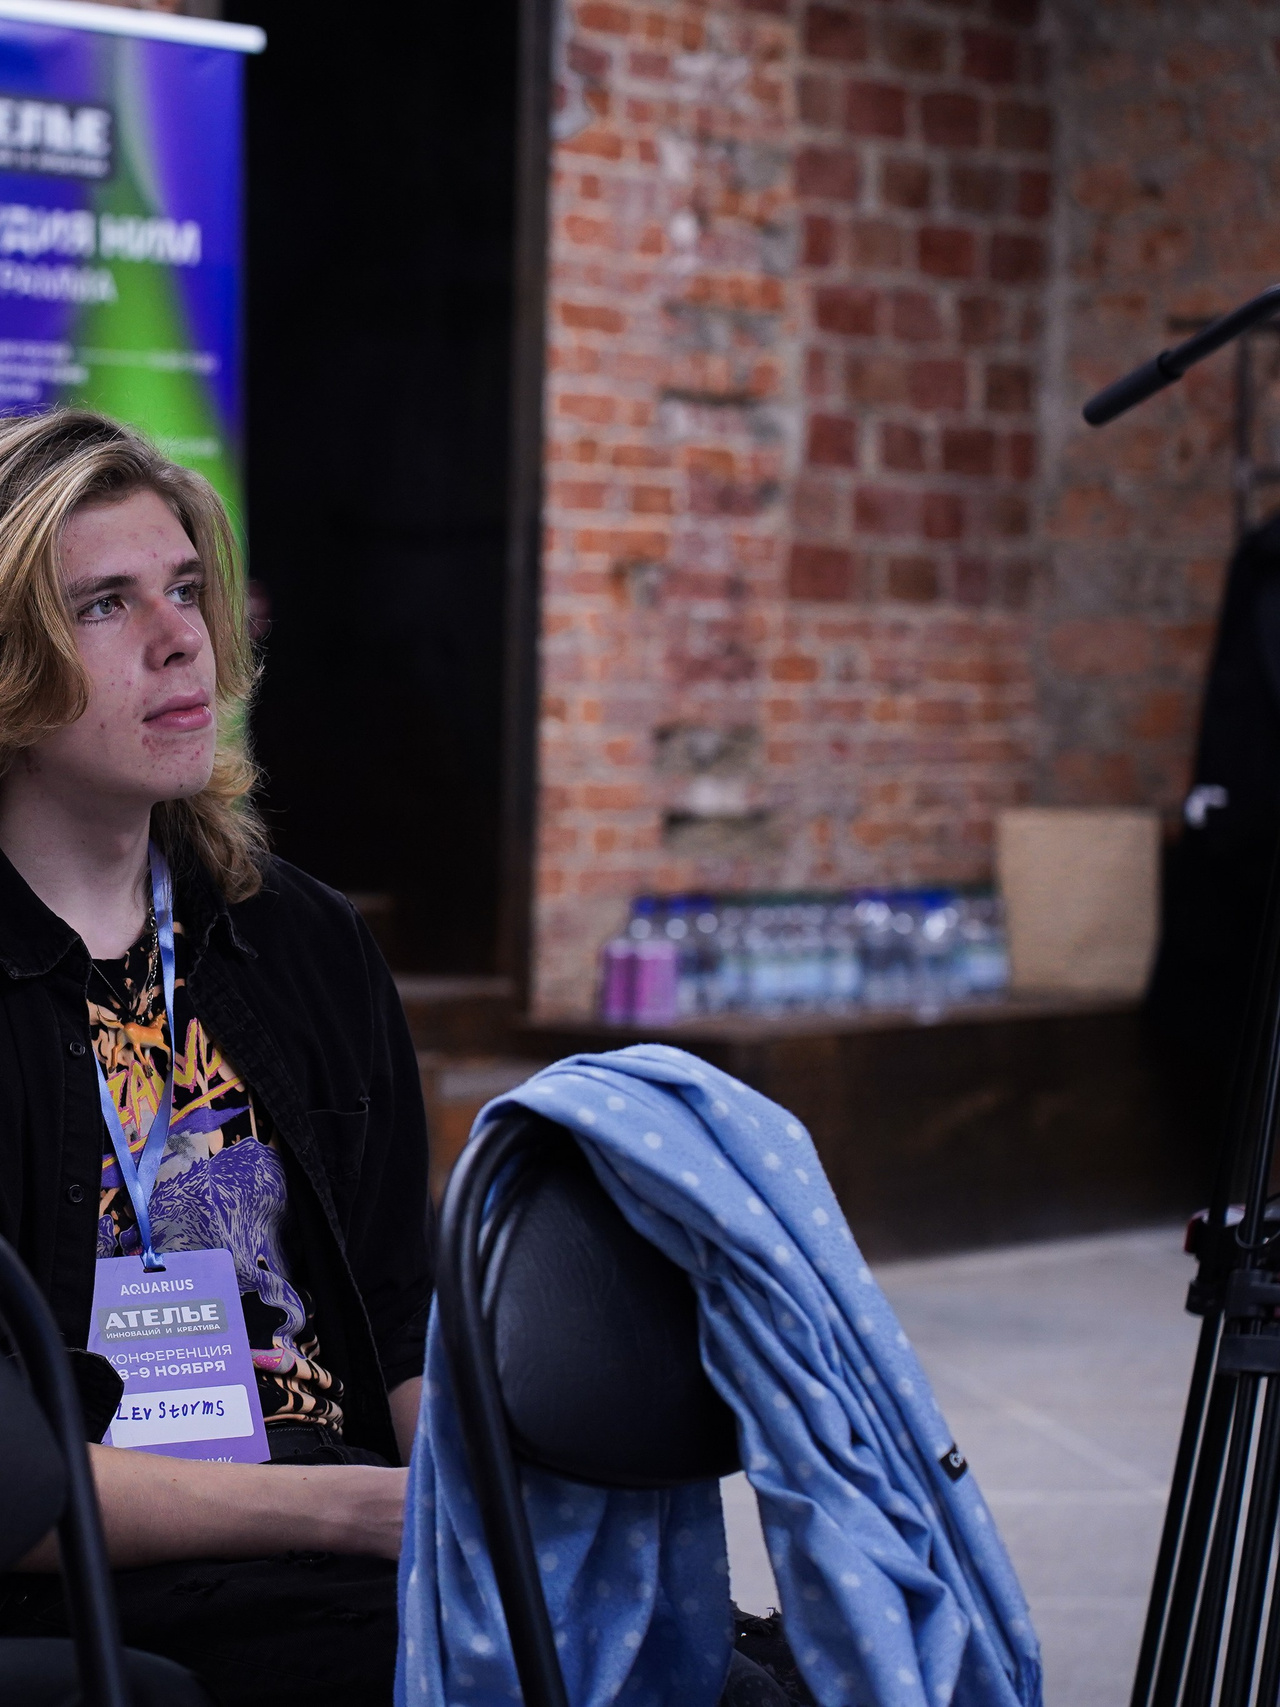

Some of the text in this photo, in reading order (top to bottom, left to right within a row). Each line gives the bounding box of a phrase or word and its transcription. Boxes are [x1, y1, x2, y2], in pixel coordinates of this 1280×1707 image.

[120, 1278, 194, 1296] AQUARIUS
[105, 1303, 220, 1330] АТЕЛЬЕ
[106, 1327, 161, 1339] ИННОВАЦИЙ
[177, 1323, 220, 1333] КРЕАТИВА
[155, 1360, 226, 1377] НОЯБРЯ
